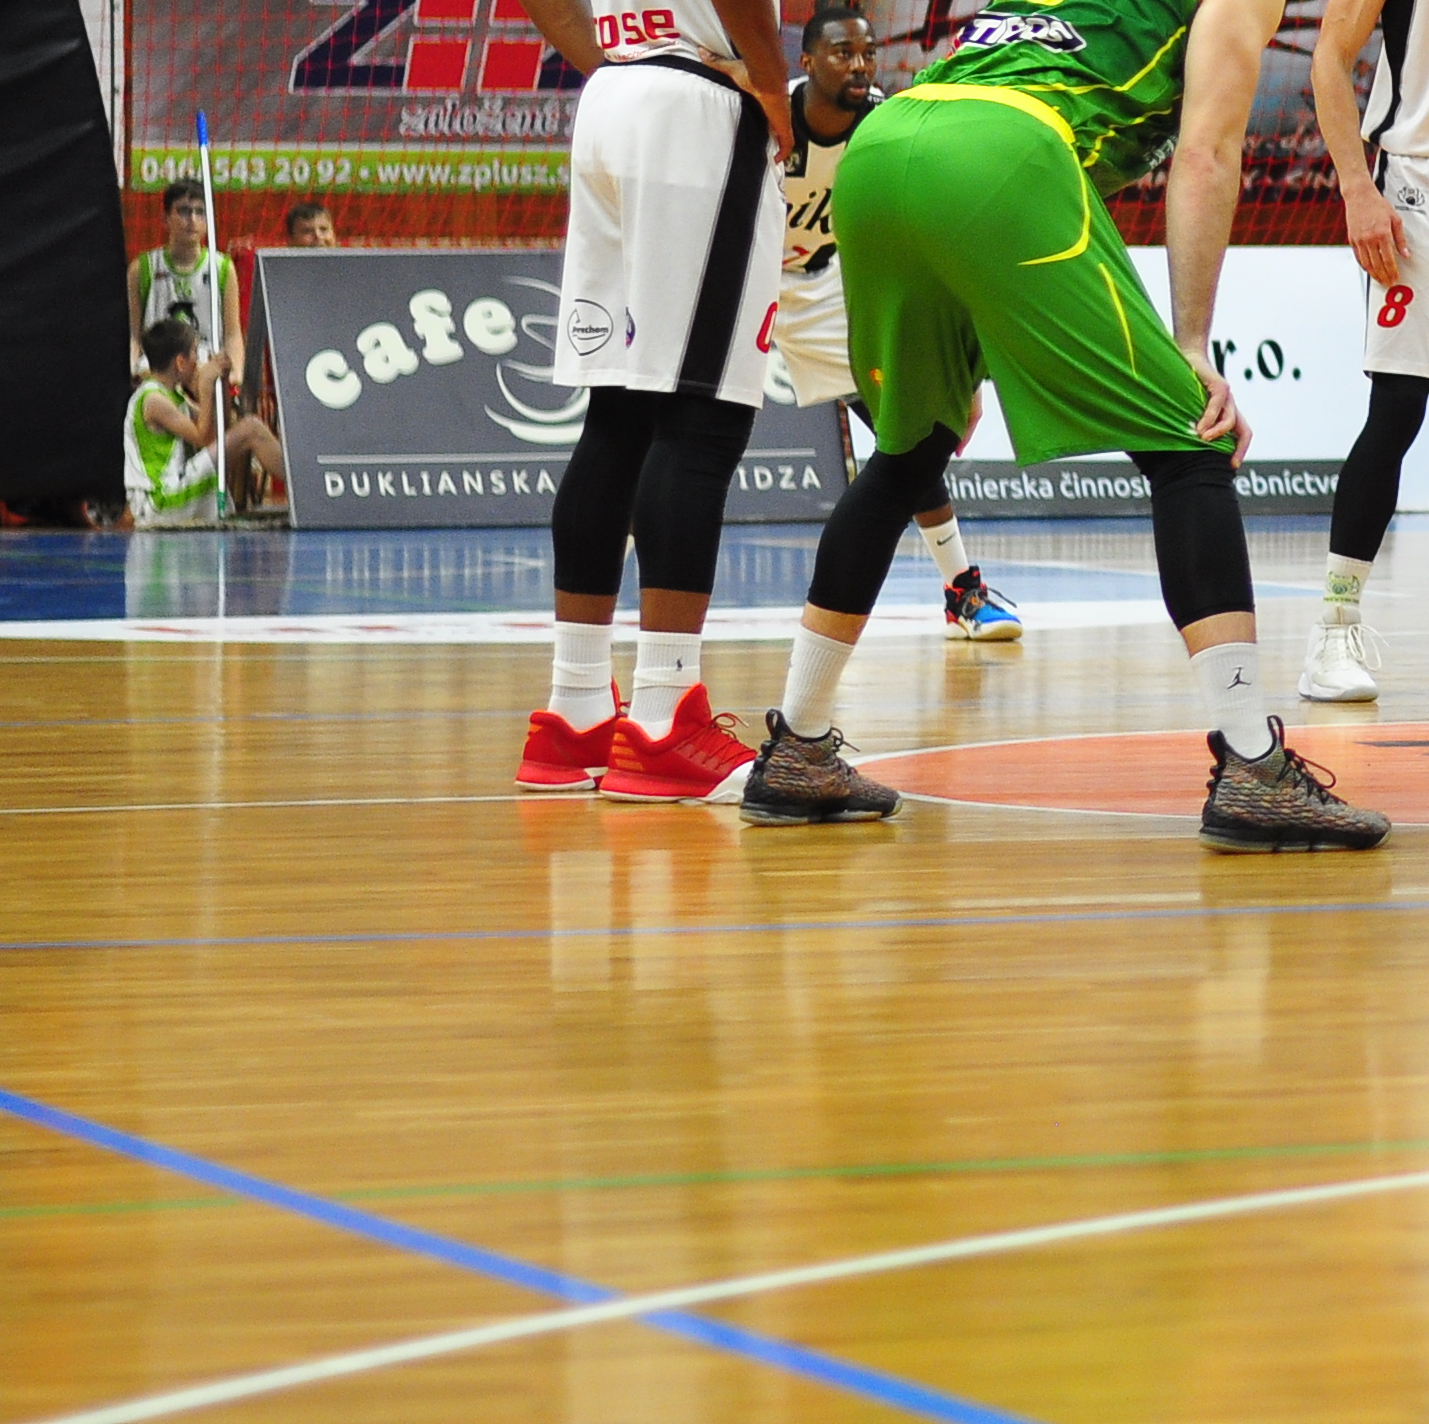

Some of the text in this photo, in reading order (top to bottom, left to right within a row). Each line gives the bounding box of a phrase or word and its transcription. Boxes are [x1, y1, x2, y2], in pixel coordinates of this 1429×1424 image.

[594, 9, 681, 49] ose
[216, 159, 266, 183] 543
[275, 159, 310, 184] 20
[317, 159, 350, 184] 92
[1377, 284, 1414, 328] 8
[306, 287, 518, 410] cafe
[325, 470, 558, 498] DUKLIANSKA
